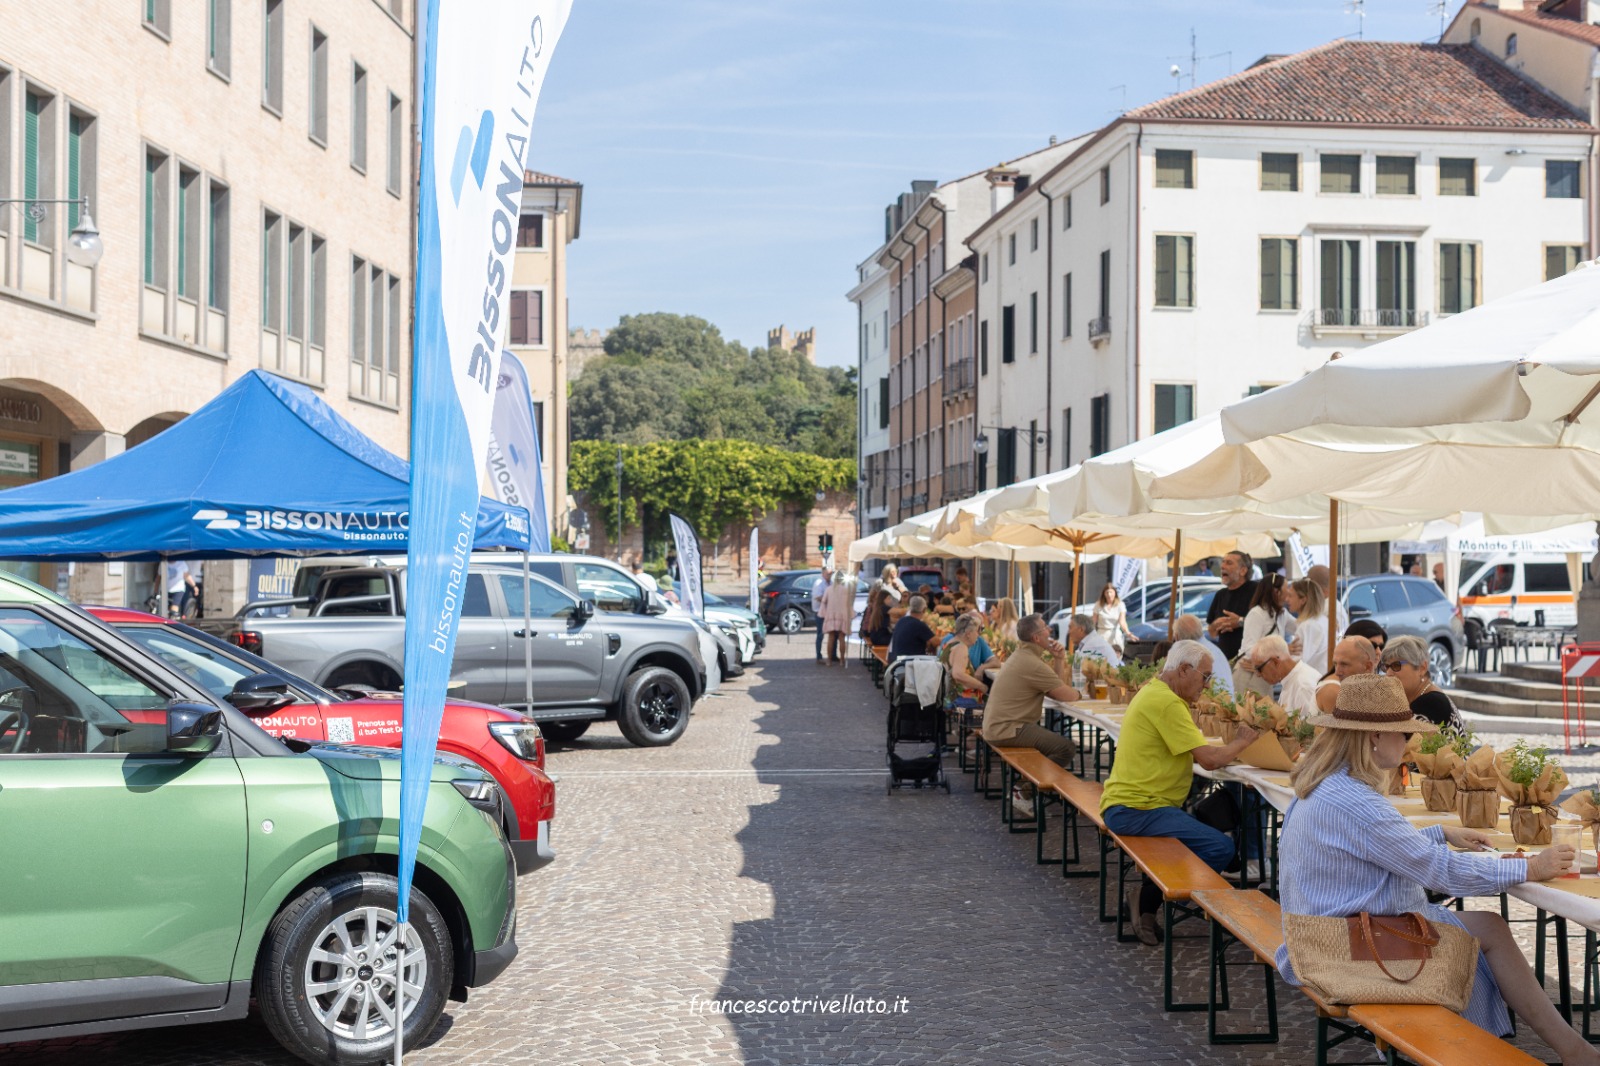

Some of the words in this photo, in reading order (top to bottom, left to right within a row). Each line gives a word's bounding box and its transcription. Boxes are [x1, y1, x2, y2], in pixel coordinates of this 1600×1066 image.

[246, 510, 409, 530] BISSONAUTO
[343, 531, 409, 541] bissonauto.
[1459, 540, 1508, 550] Montato
[275, 558, 301, 575] DANZ
[429, 511, 473, 654] bissonauto.it
[357, 720, 386, 728] Prenota
[378, 727, 395, 735] Test
